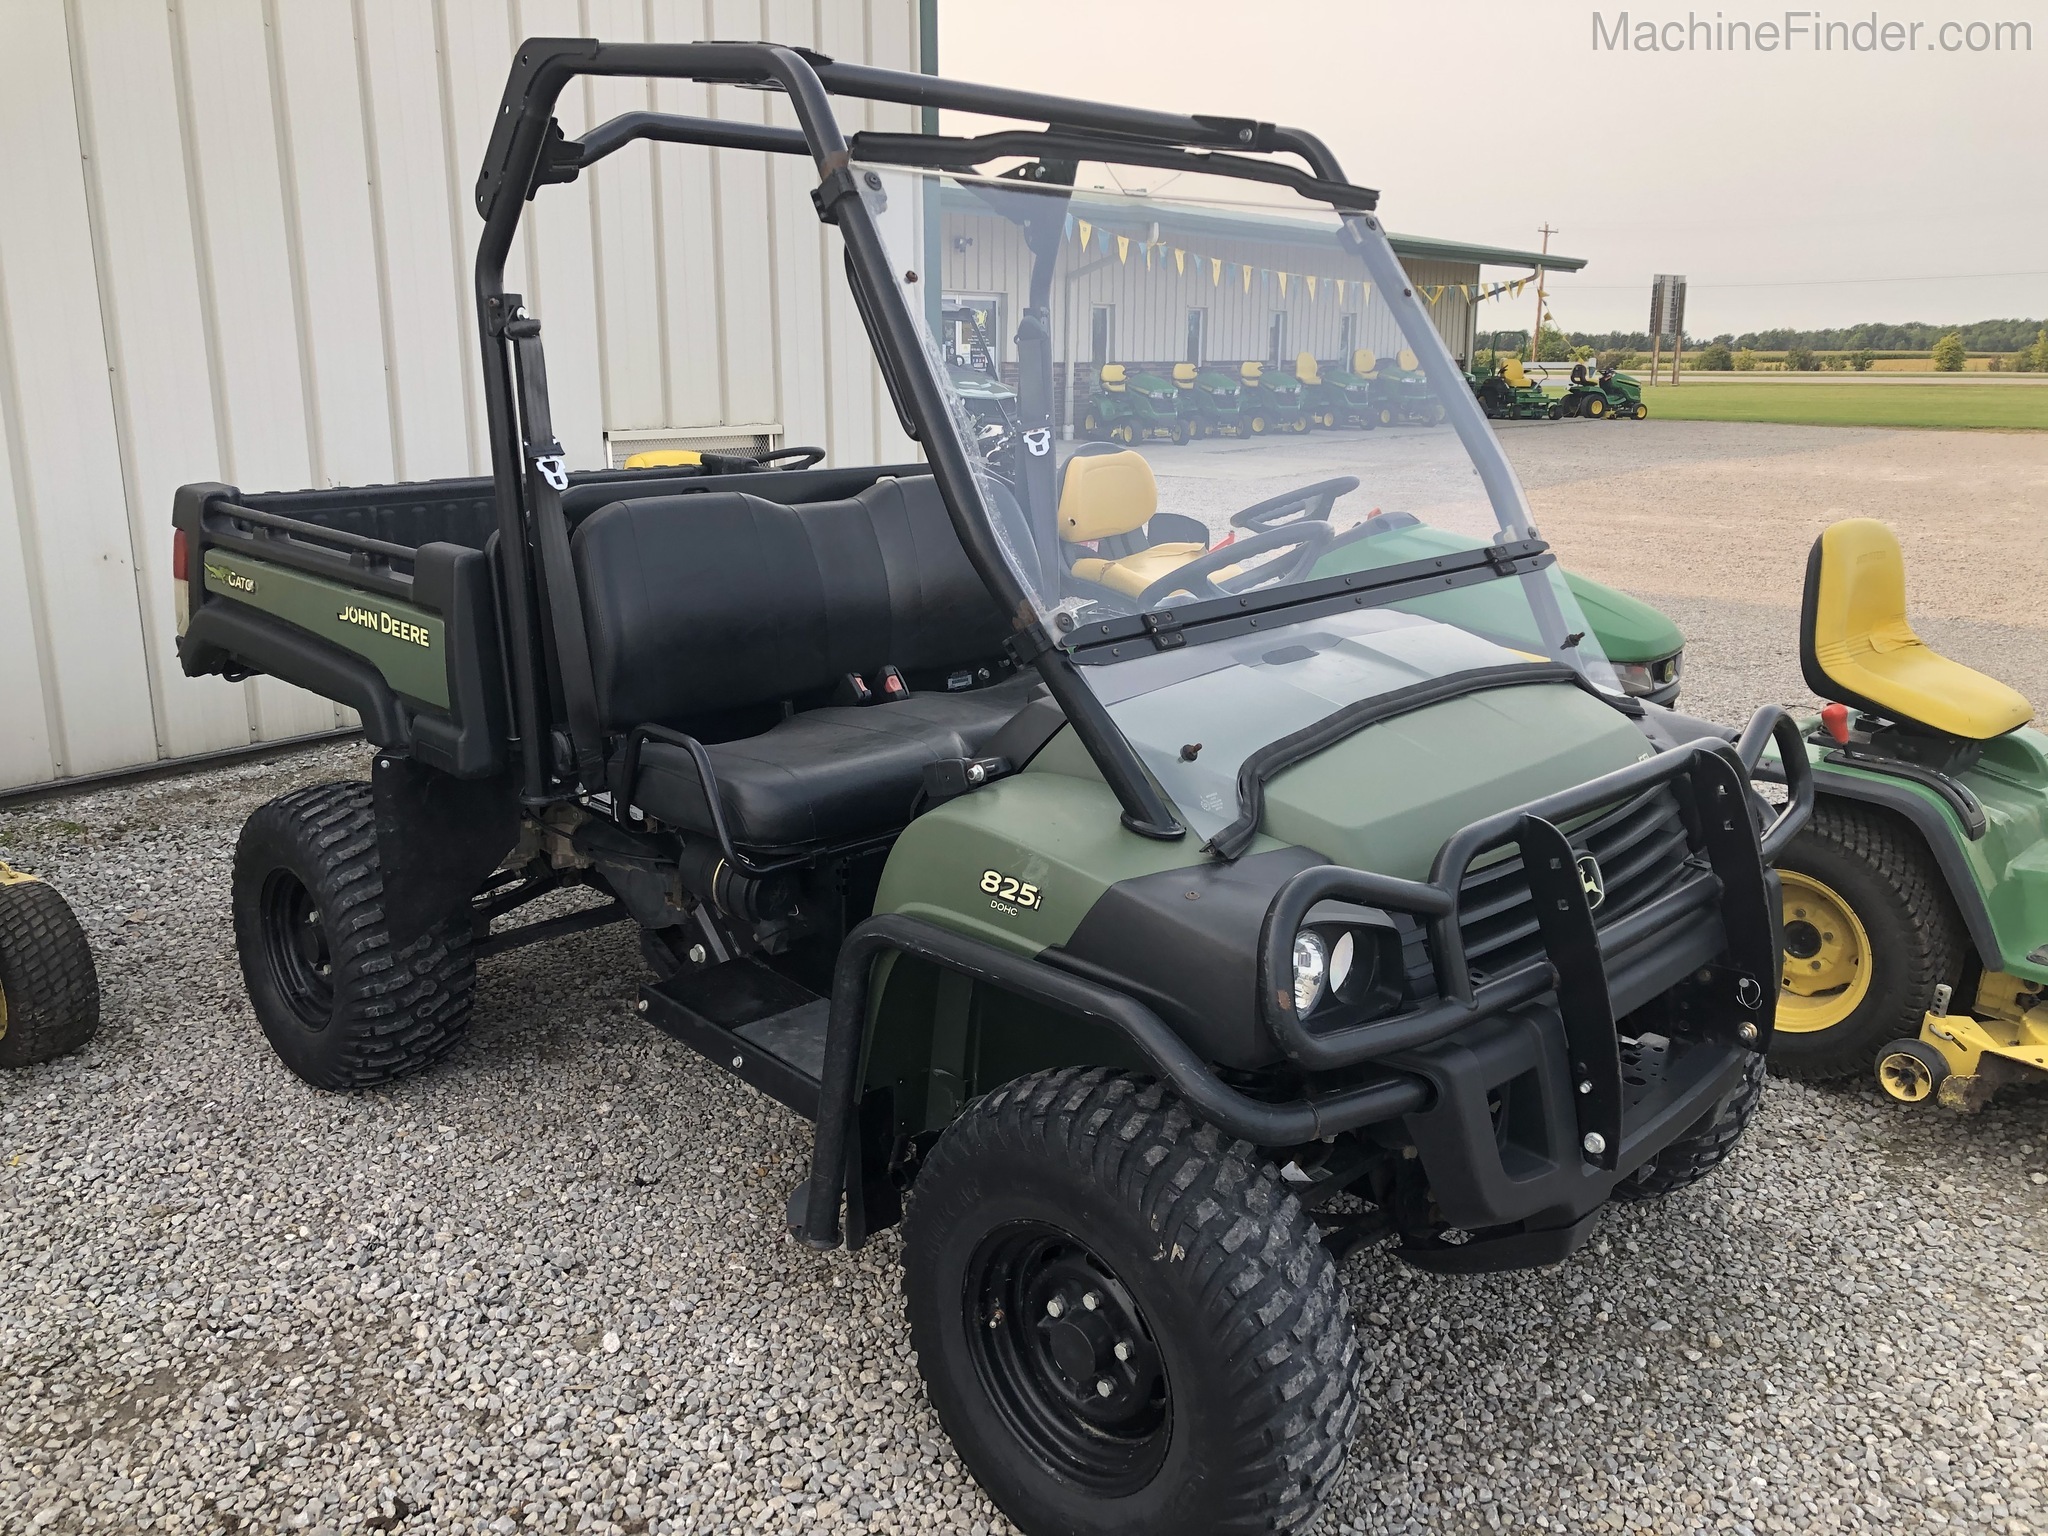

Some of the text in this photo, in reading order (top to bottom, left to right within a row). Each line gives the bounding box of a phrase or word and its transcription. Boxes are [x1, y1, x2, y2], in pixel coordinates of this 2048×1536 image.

[228, 571, 255, 593] GATO
[338, 605, 431, 648] JOHN DEERE
[979, 868, 1043, 911] 825i
[990, 900, 1019, 917] DOHC
